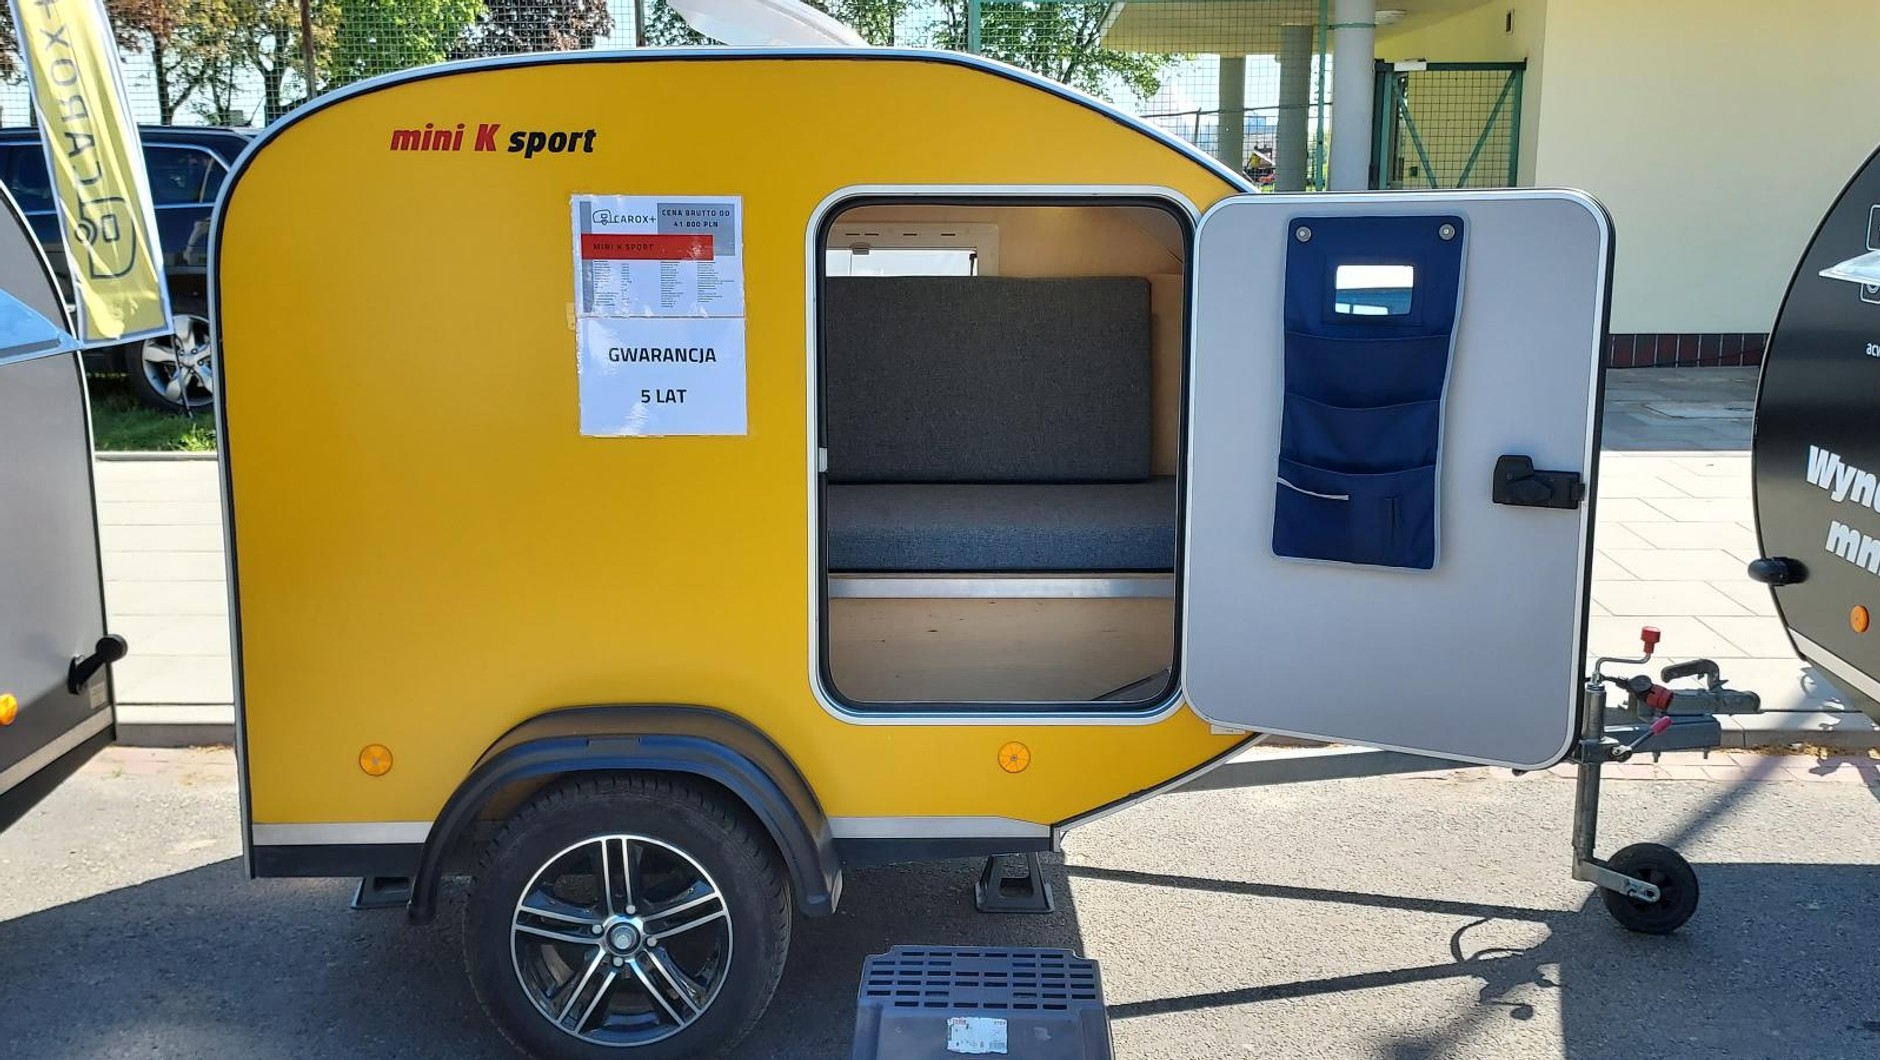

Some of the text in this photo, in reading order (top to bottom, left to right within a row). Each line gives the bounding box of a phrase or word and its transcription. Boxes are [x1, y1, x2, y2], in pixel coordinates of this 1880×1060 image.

[390, 123, 597, 158] mini K sport
[661, 209, 682, 217] CENA
[625, 243, 654, 251] SPORT
[608, 347, 717, 363] GWARANCJA
[641, 389, 687, 403] 5 LAT
